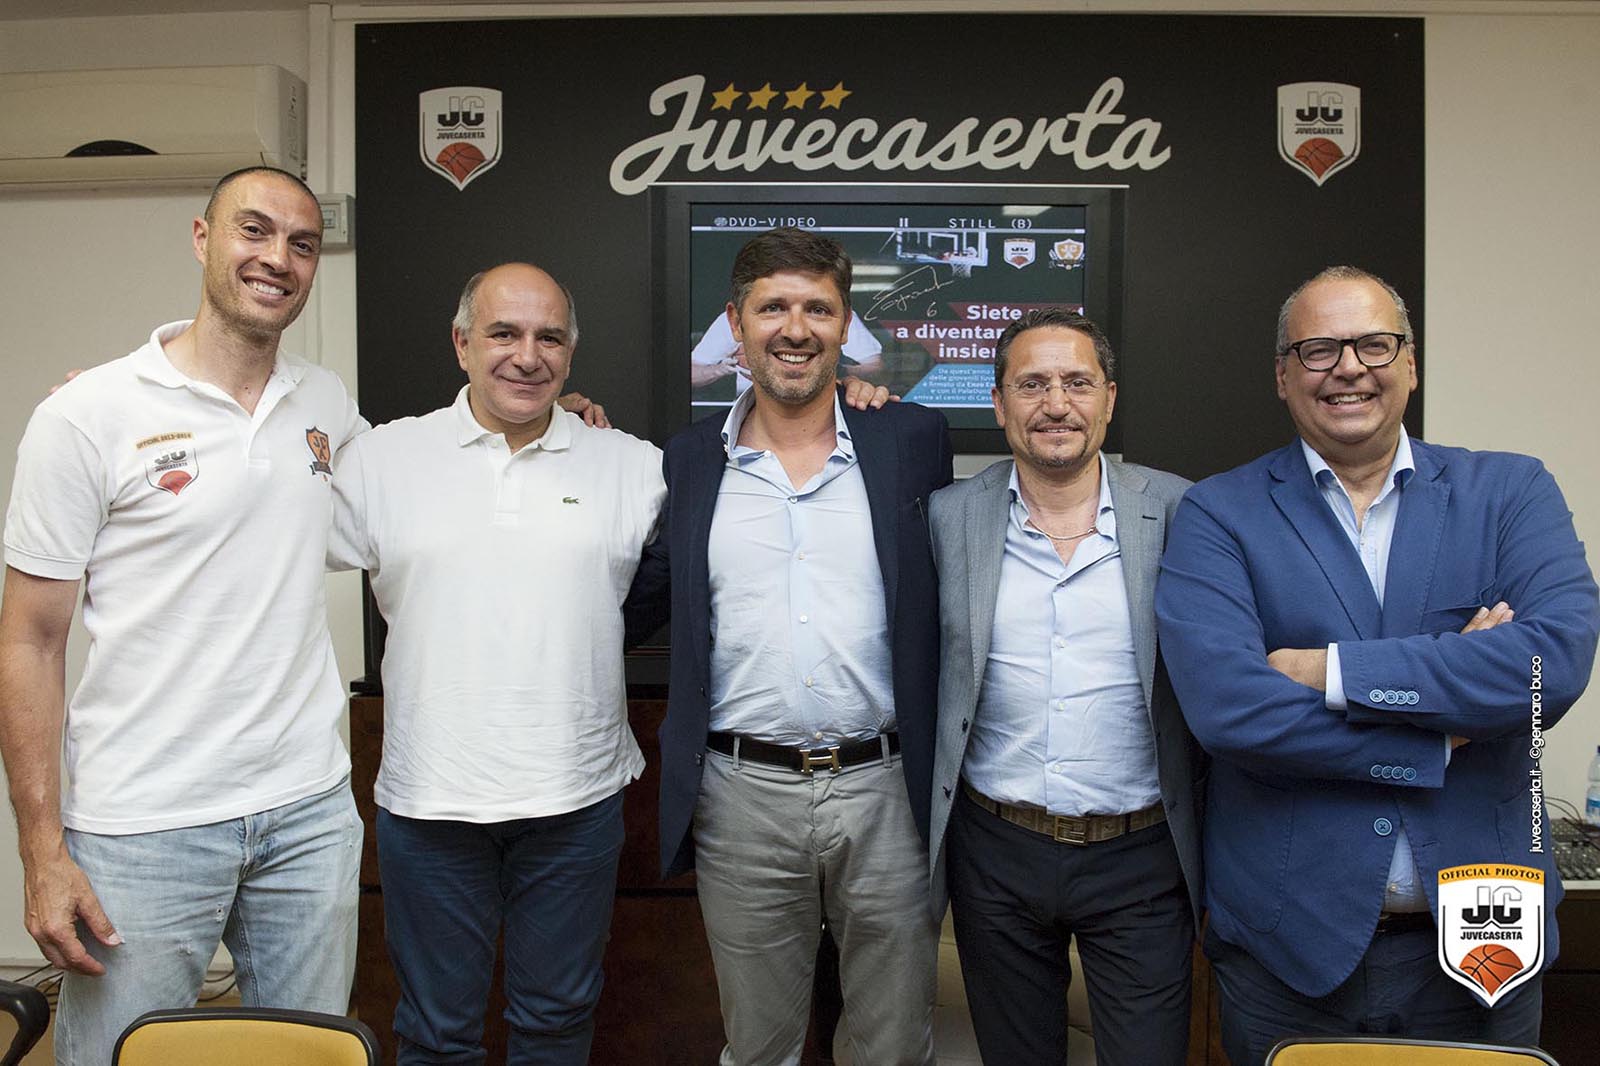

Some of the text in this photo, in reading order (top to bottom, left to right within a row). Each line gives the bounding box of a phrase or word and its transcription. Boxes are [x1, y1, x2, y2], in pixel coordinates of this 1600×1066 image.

[437, 96, 485, 127] JC
[437, 131, 485, 140] JUVECASERTA
[609, 74, 1172, 196] Juvecaserta
[729, 217, 816, 228] DVD-VIDEO
[949, 217, 996, 228] STILL
[967, 304, 1022, 320] Siete
[896, 327, 909, 339] a
